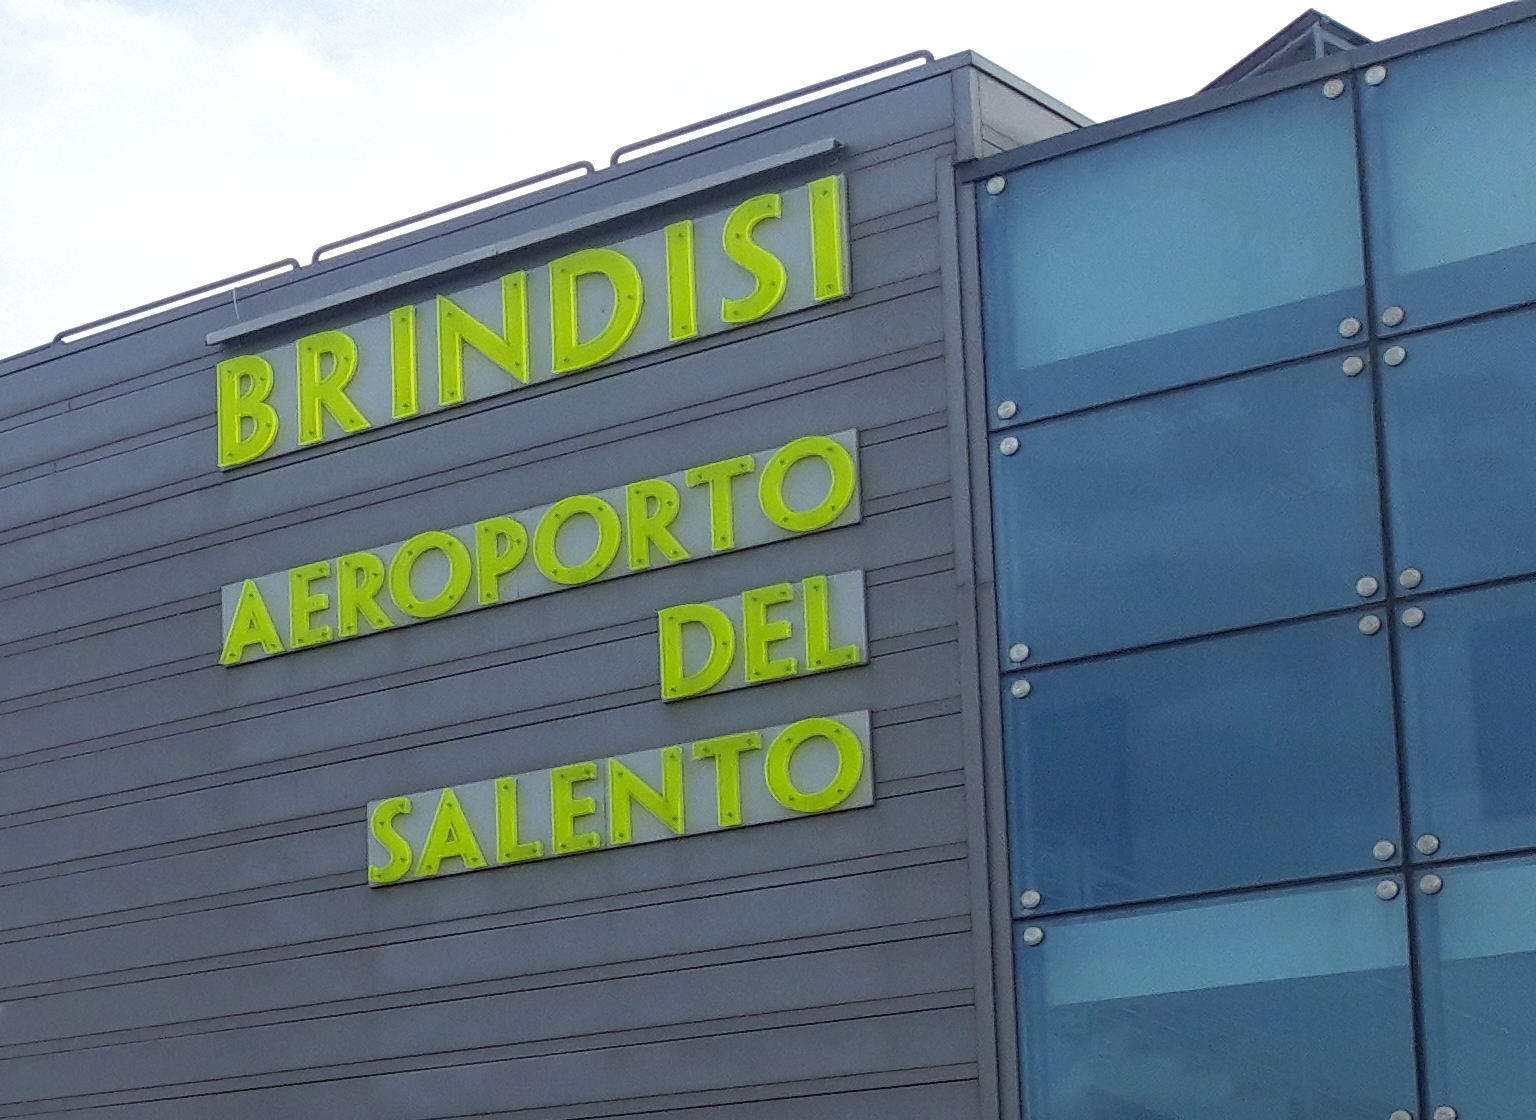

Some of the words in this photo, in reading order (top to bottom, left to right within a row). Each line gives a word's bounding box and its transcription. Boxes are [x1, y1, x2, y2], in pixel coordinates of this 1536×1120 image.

[217, 175, 846, 469] BRINDISI
[218, 435, 857, 664] AEROPORTO
[658, 575, 860, 701] DEL
[368, 717, 865, 884] SALENTO
